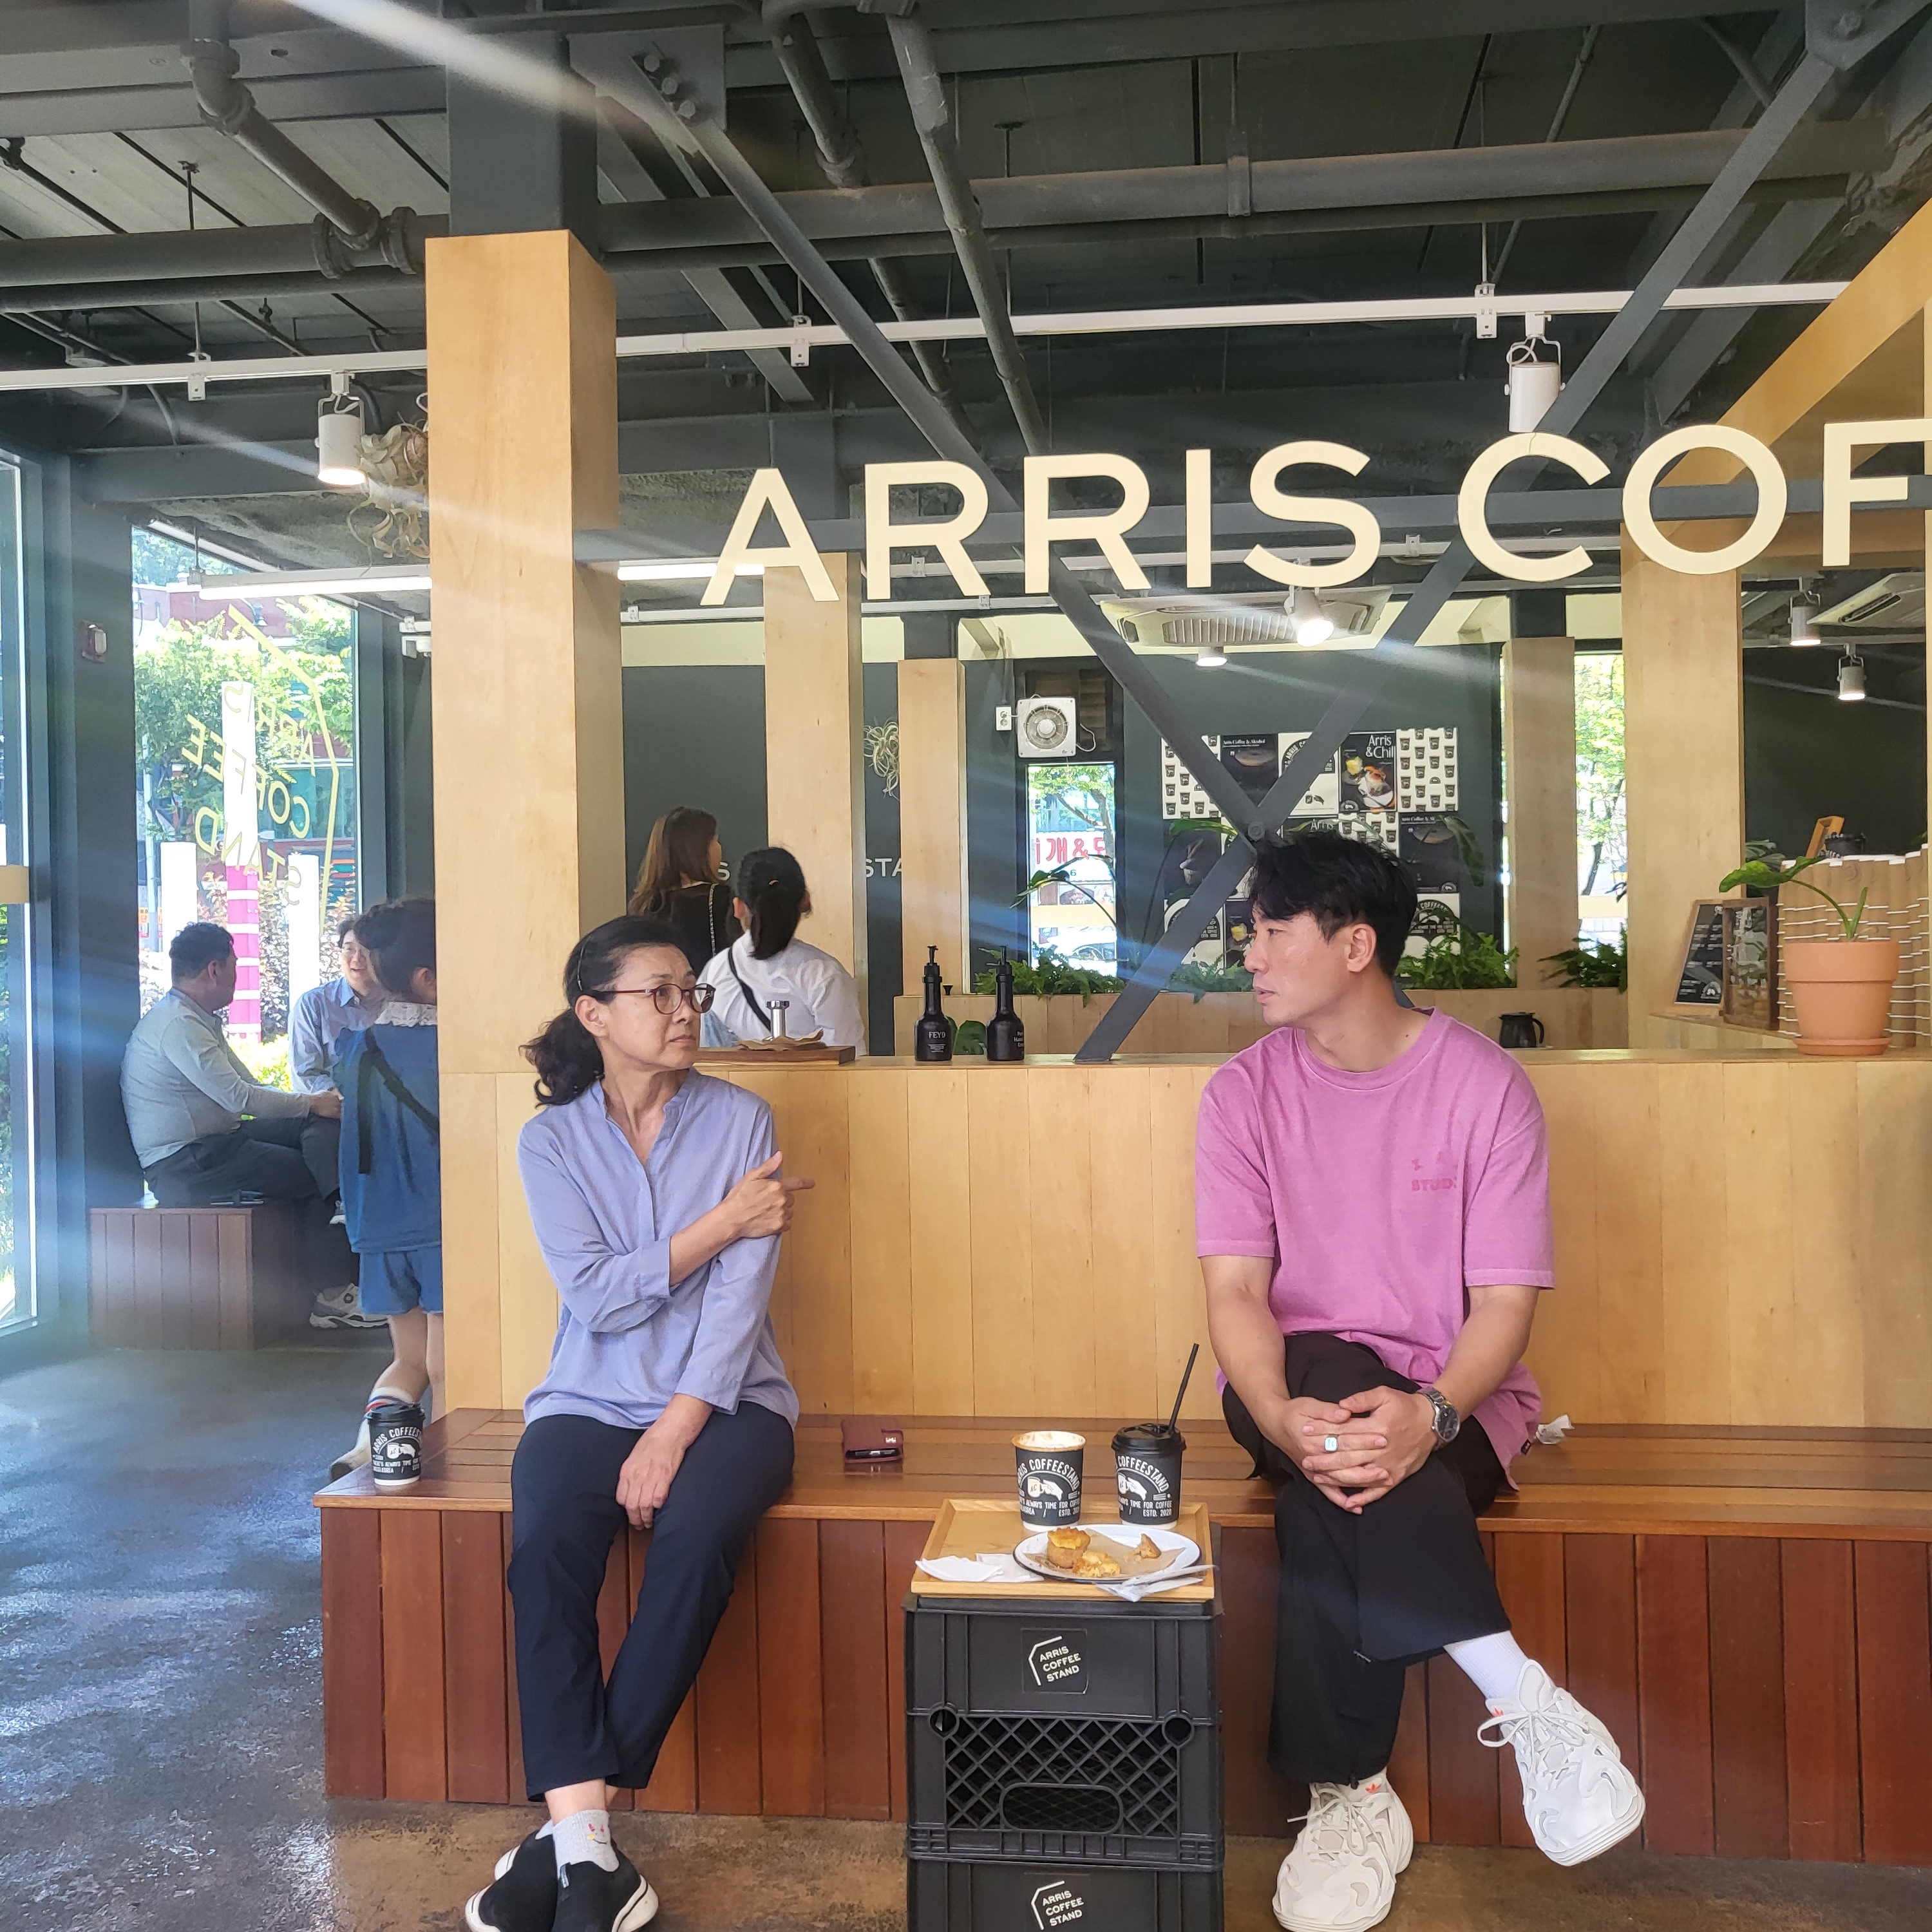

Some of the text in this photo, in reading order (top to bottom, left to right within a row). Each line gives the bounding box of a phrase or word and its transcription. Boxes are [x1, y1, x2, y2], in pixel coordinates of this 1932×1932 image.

[699, 440, 1381, 606] ARRIS
[1368, 735, 1392, 747] Arris
[1028, 1459, 1080, 1490] COFFEESTAND
[1117, 1455, 1170, 1493] COFFEESTAND
[1045, 1501, 1057, 1510] TIME
[1130, 1499, 1141, 1509] TIME
[1155, 1500, 1172, 1509] COFFEE
[1039, 1646, 1069, 1662] ARRIS
[1043, 1653, 1081, 1672] COFFEE
[1046, 1665, 1080, 1682] STAND
[1043, 1890, 1072, 1906] ARRIS
[1046, 1897, 1084, 1917] COFFEE
[1049, 1909, 1083, 1927] STAND
